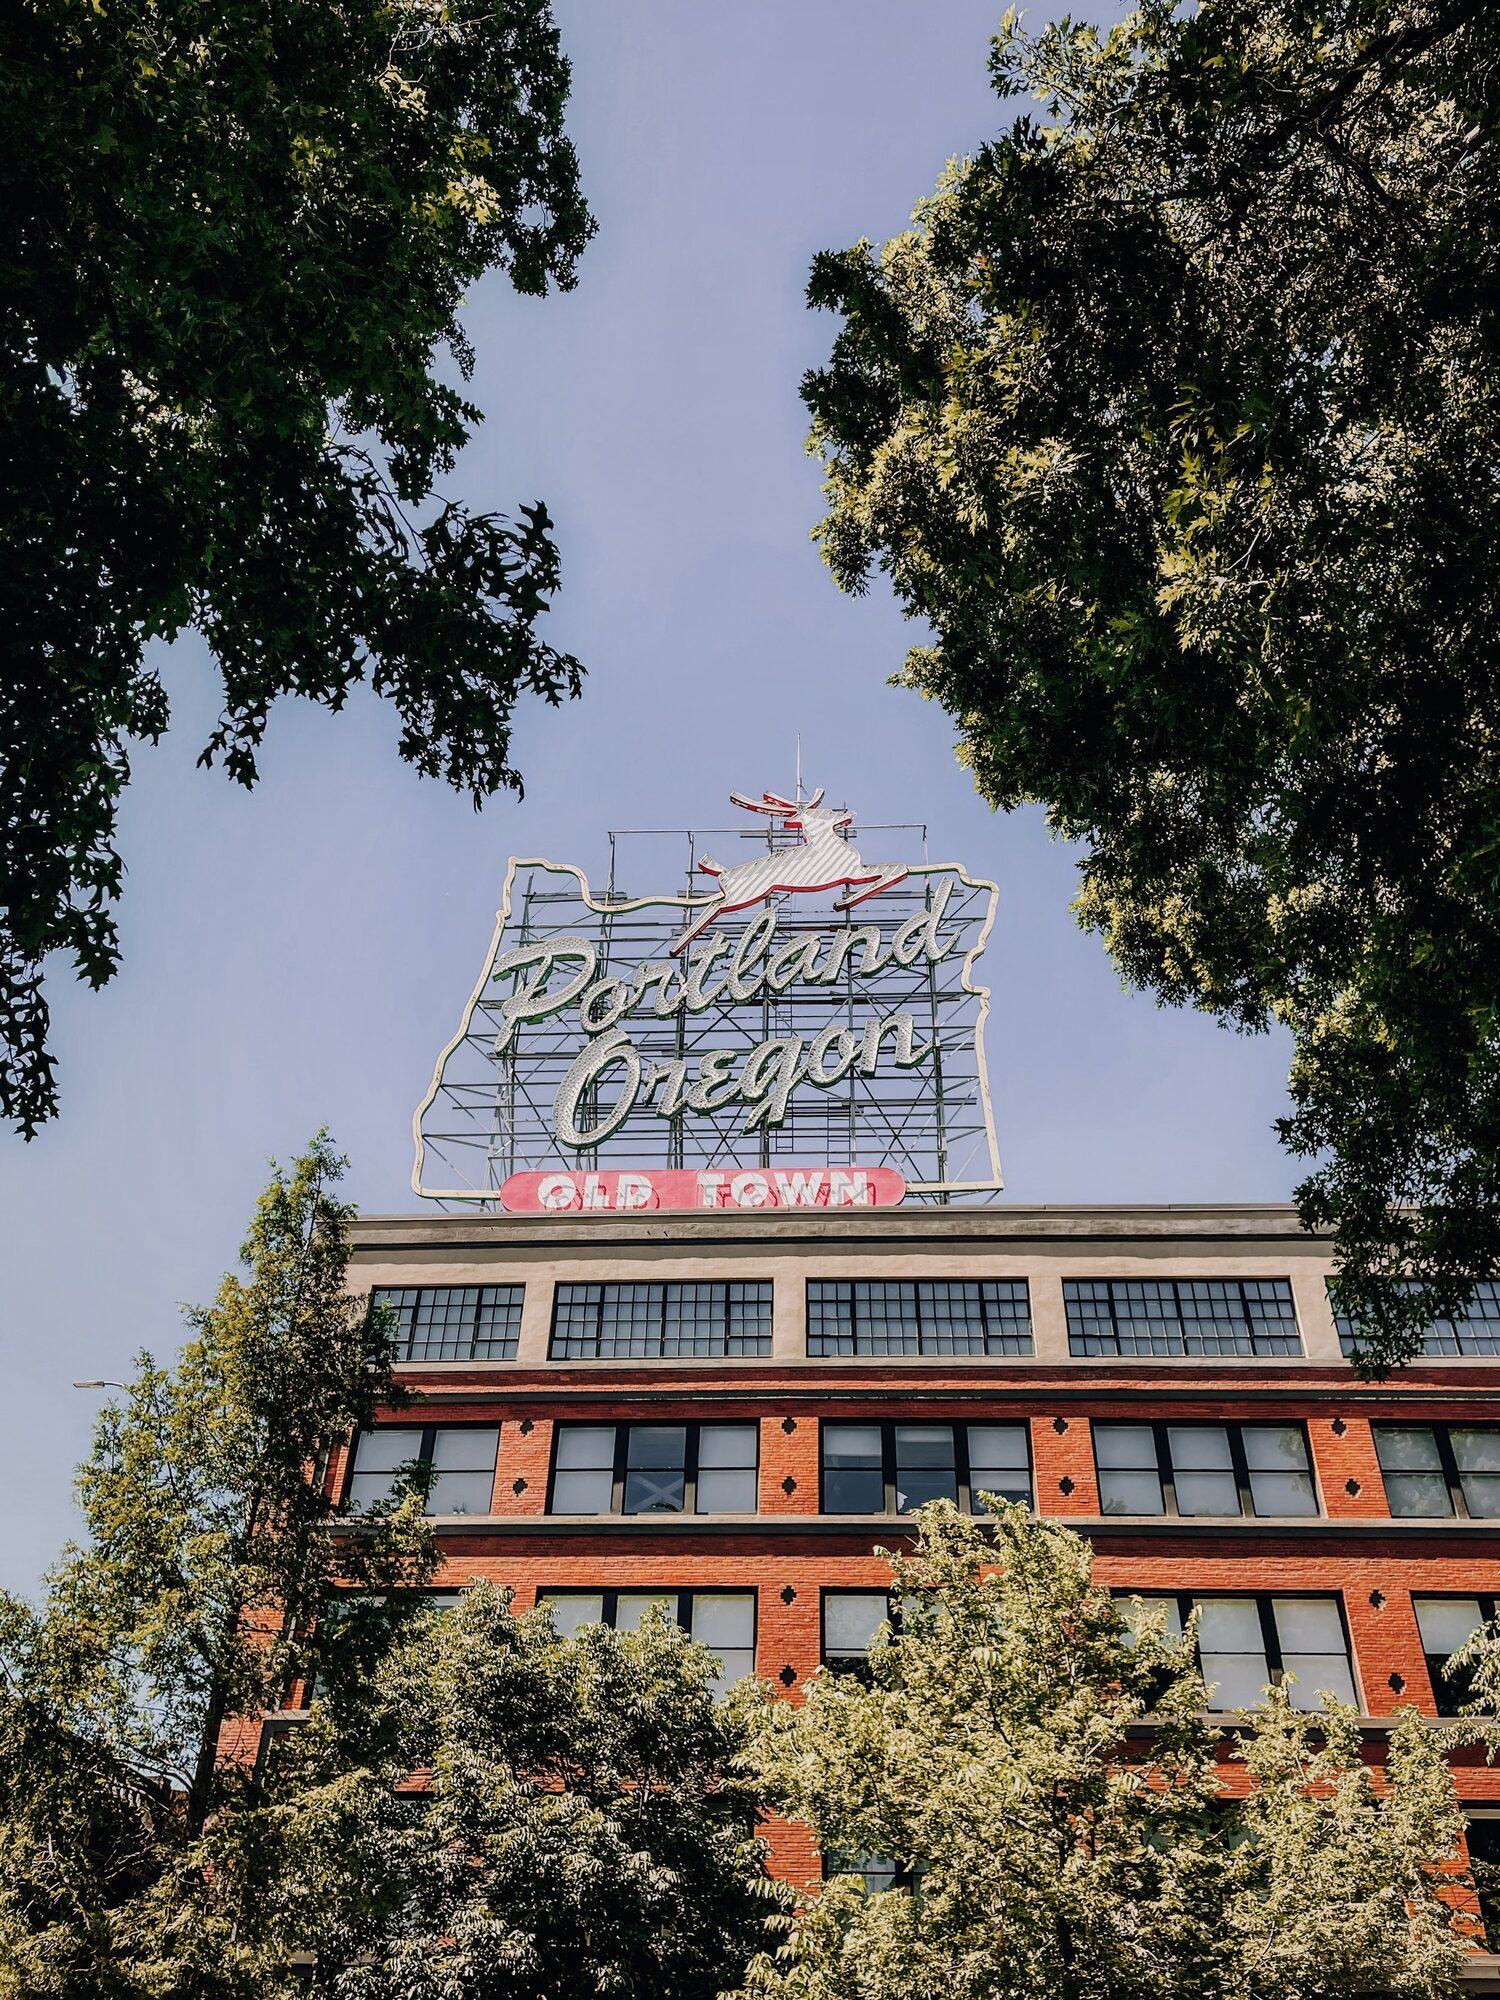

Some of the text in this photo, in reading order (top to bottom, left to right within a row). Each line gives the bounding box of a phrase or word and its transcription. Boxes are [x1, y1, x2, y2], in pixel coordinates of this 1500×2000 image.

[493, 877, 961, 1054] Portland
[553, 1012, 936, 1148] Oregon
[537, 1171, 870, 1209] OLD TOWN
